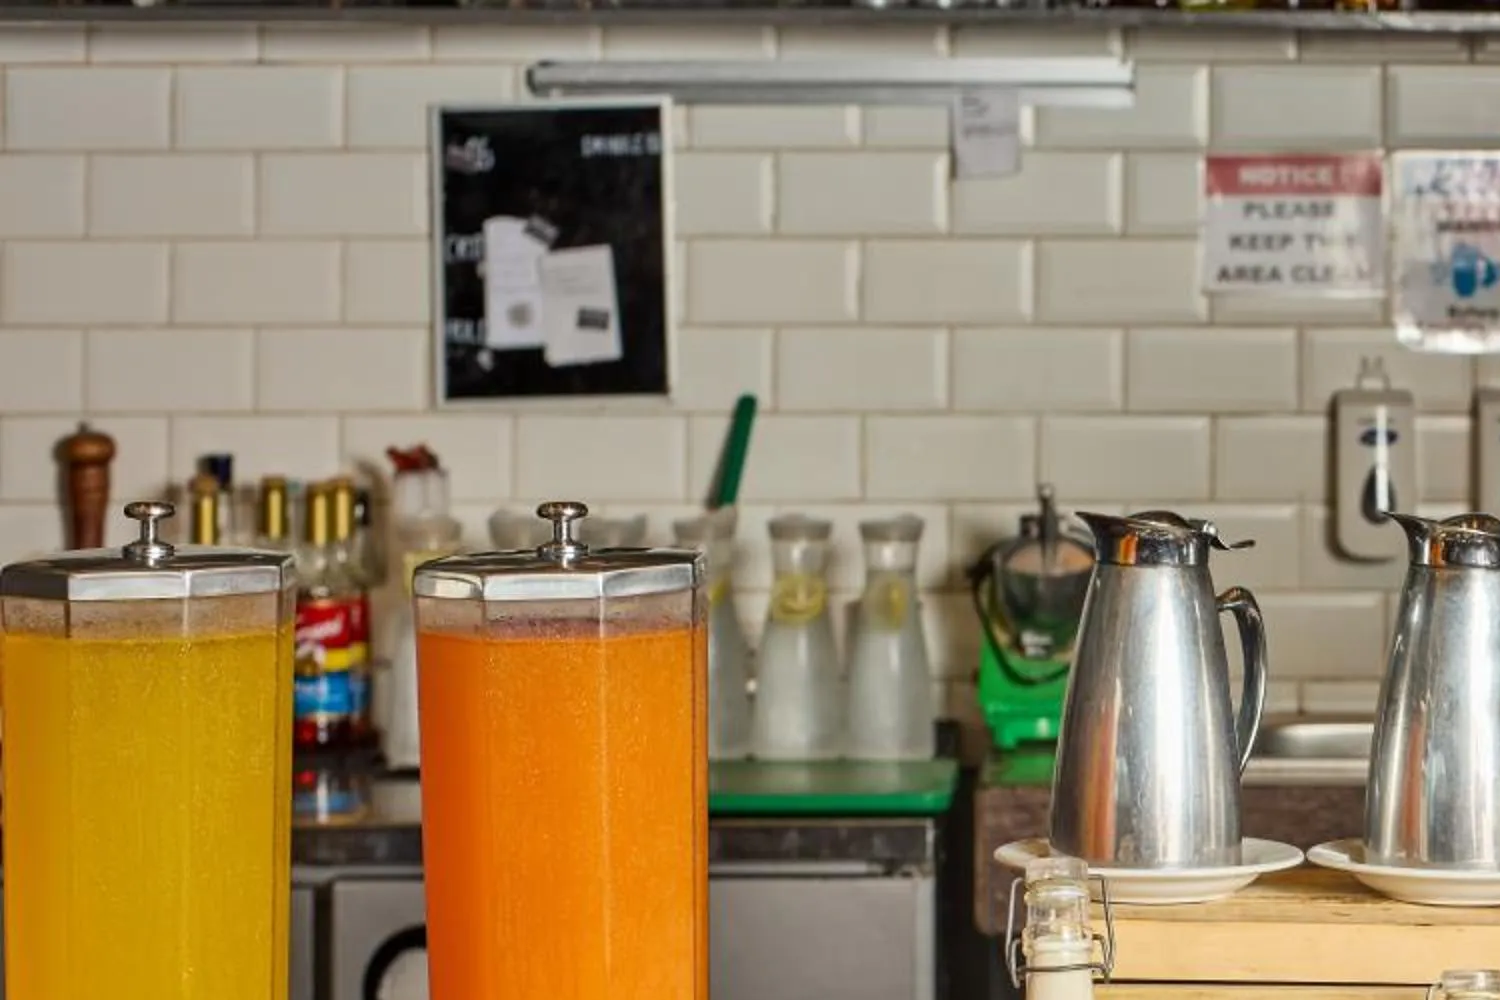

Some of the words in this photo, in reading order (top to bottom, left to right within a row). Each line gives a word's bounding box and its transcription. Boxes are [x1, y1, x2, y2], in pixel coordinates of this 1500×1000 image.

[1238, 164, 1334, 188] NOTICE
[1242, 202, 1335, 220] PLEASE
[1229, 233, 1293, 252] KEEP
[1217, 265, 1283, 284] AREA
